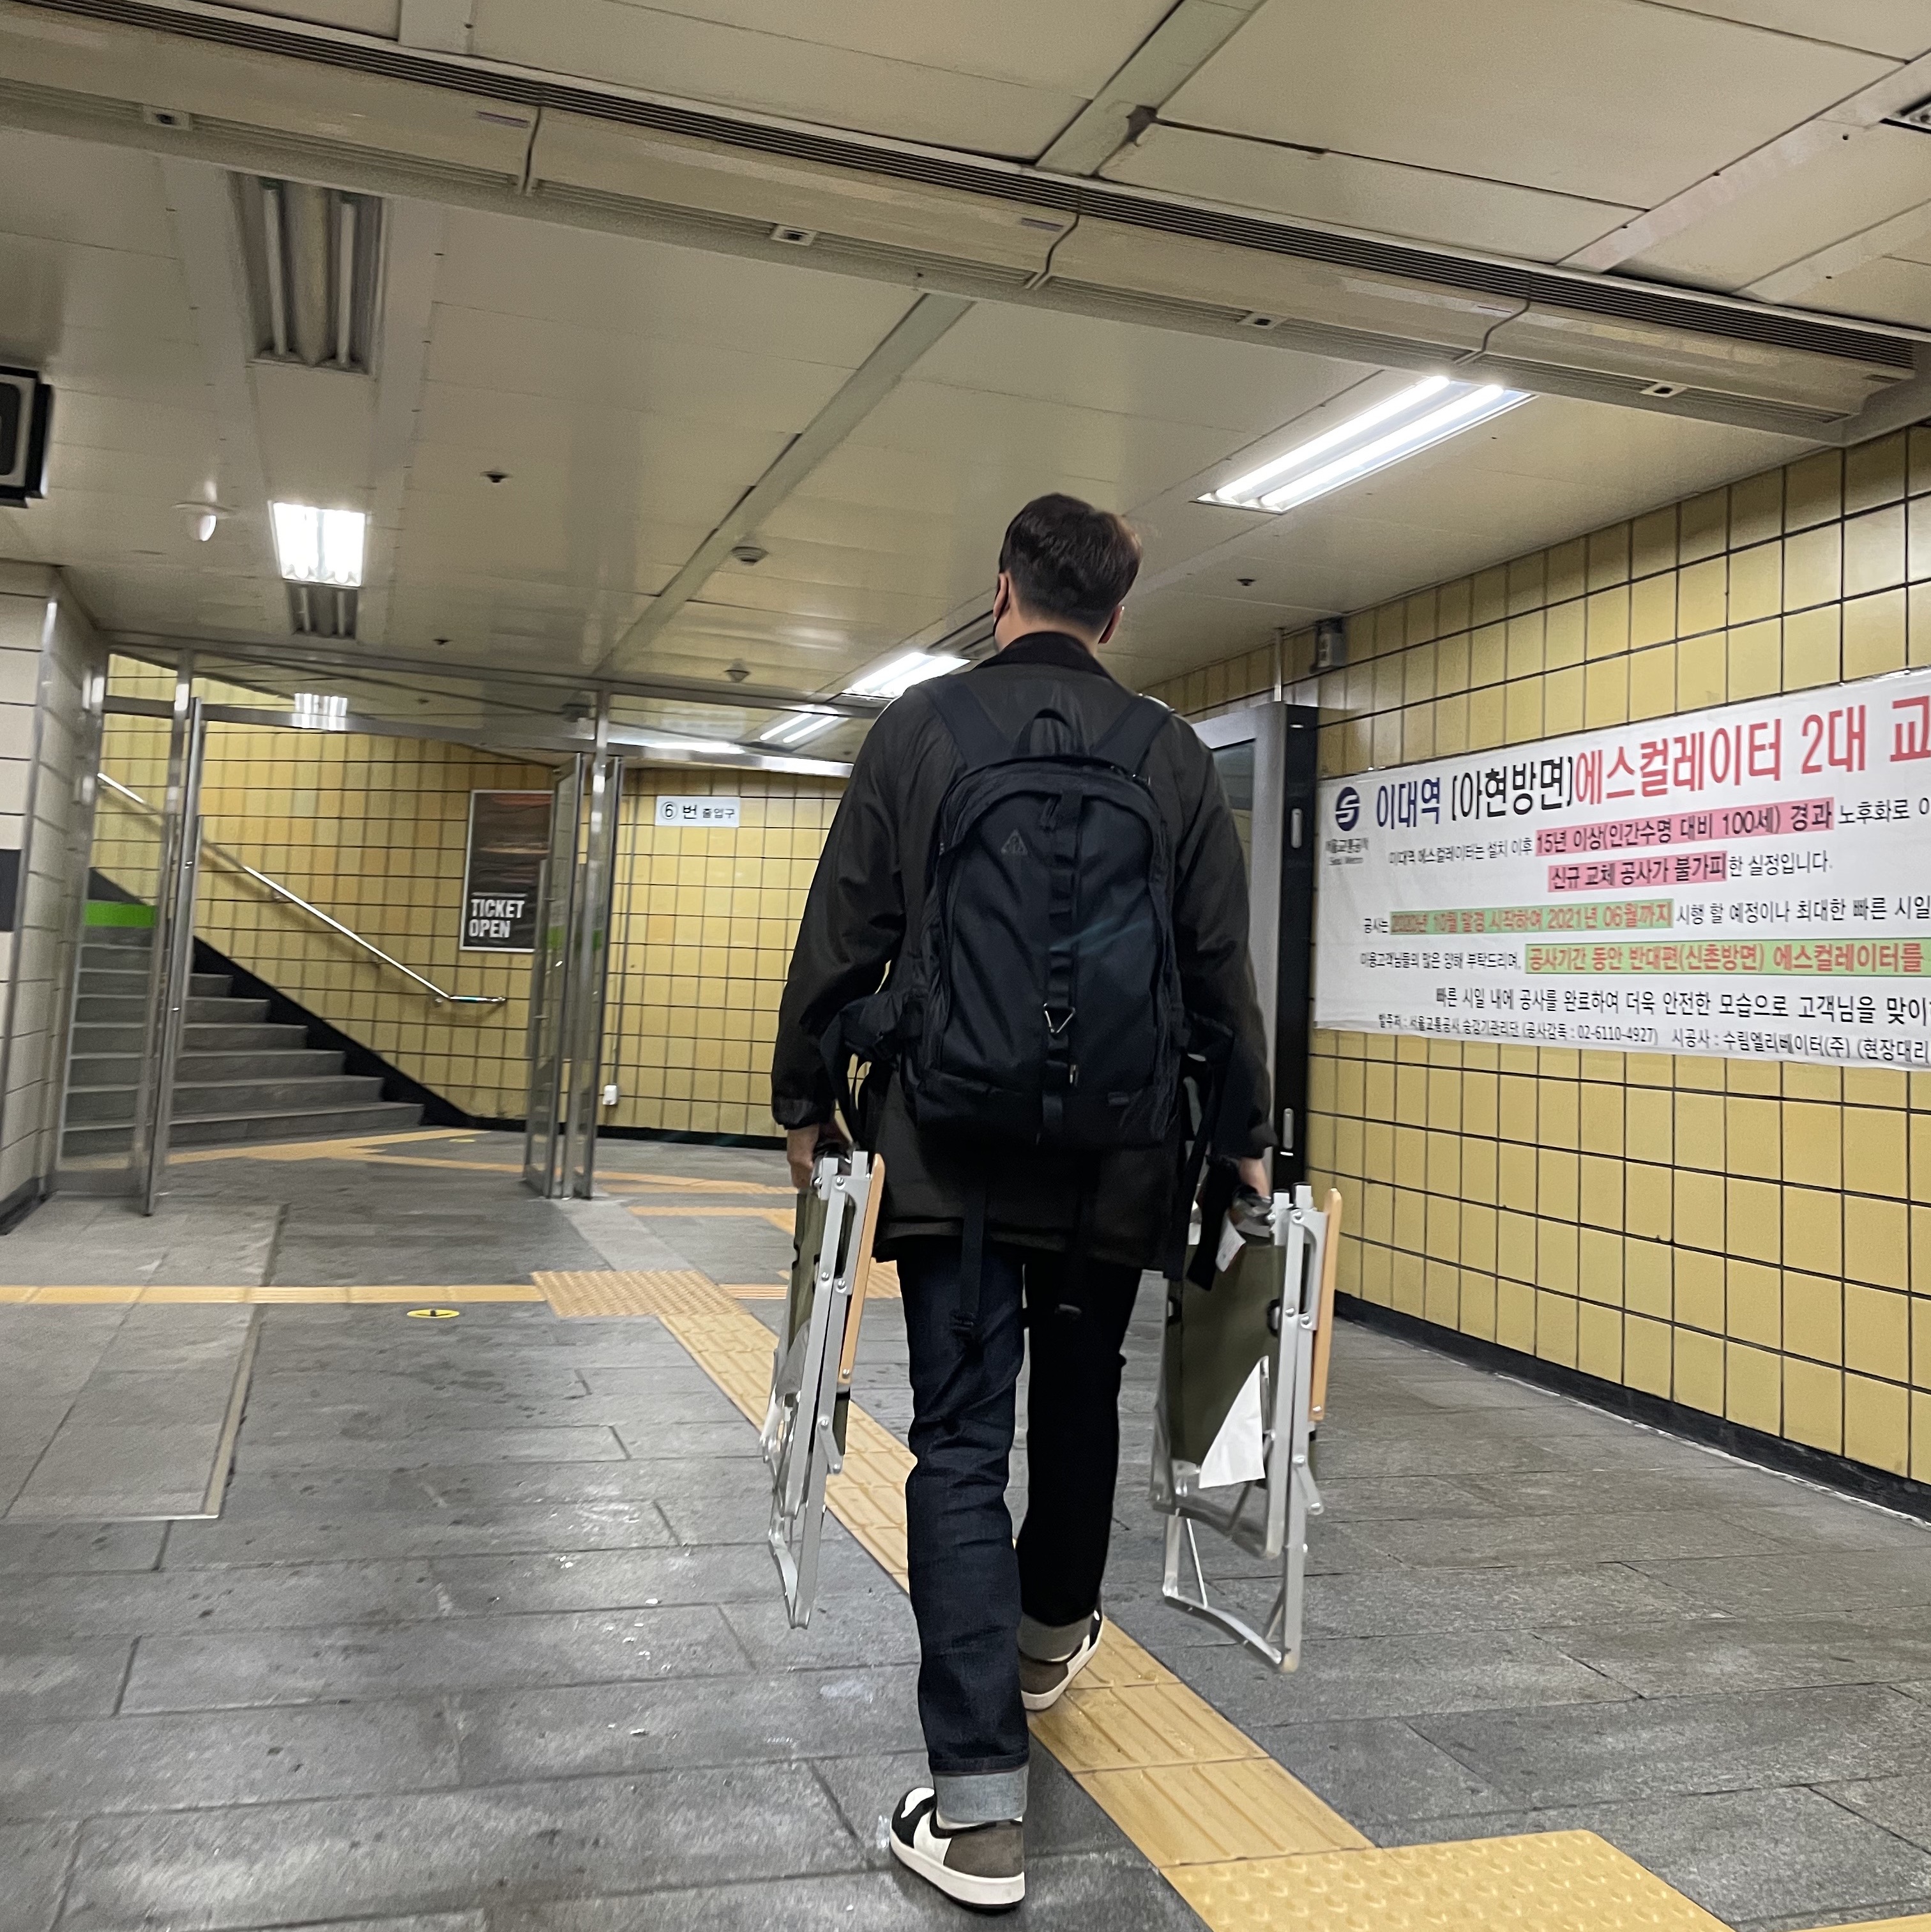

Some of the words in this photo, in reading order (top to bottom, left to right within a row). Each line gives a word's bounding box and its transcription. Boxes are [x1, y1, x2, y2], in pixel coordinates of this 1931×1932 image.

[1376, 777, 1440, 830] 이대역
[1800, 704, 1866, 774] 2대
[1889, 694, 1931, 763] 교
[683, 804, 698, 819] 번
[702, 808, 735, 819] 출입구
[1418, 843, 1485, 863] 에스컬레이터는
[1488, 839, 1508, 858] 설치
[1511, 837, 1533, 856] 이후
[1536, 830, 1566, 855] 15년
[1573, 818, 1671, 851] 이상(인간수명
[1680, 813, 1713, 840] 대비
[1722, 805, 1781, 835] 100세)
[1790, 801, 1832, 832] 경과
[1838, 799, 1911, 825] 노후화로
[1551, 866, 1580, 890] 신규
[1585, 862, 1616, 886] 교체
[1621, 858, 1669, 885] 공사가
[1748, 850, 1833, 877] 실정입니다.
[471, 899, 525, 918] TICKET
[1364, 918, 1389, 934] 공사는
[1548, 905, 1598, 930] 2021년
[1603, 902, 1671, 928] 06월까지
[1676, 903, 1704, 925] 시행
[1710, 902, 1723, 924] 할
[1729, 901, 1790, 924] 예정이나
[1796, 897, 1845, 922] 최대한
[1853, 897, 1887, 920] 빠른
[1895, 895, 1931, 920] 시일
[469, 918, 511, 938] OPEN
[1529, 947, 1586, 971] 공사기간
[1592, 946, 1623, 971] 동안
[1630, 943, 1764, 971] 반대편(신촌방면)
[1773, 942, 1925, 973] 에스컬레이터를
[1436, 987, 1458, 1007] 빠른
[1462, 987, 1485, 1009] 시일
[1490, 988, 1514, 1010] 내에
[1520, 989, 1558, 1012] 공사를
[1564, 990, 1619, 1014] 완료하여
[1626, 991, 1656, 1015] 더욱
[1663, 991, 1711, 1016] 안전한
[1719, 993, 1789, 1019] 모습으로
[1798, 994, 1876, 1024] 고객님을
[1886, 996, 1931, 1026] 맞이
[1672, 1028, 1710, 1049] 시공사
